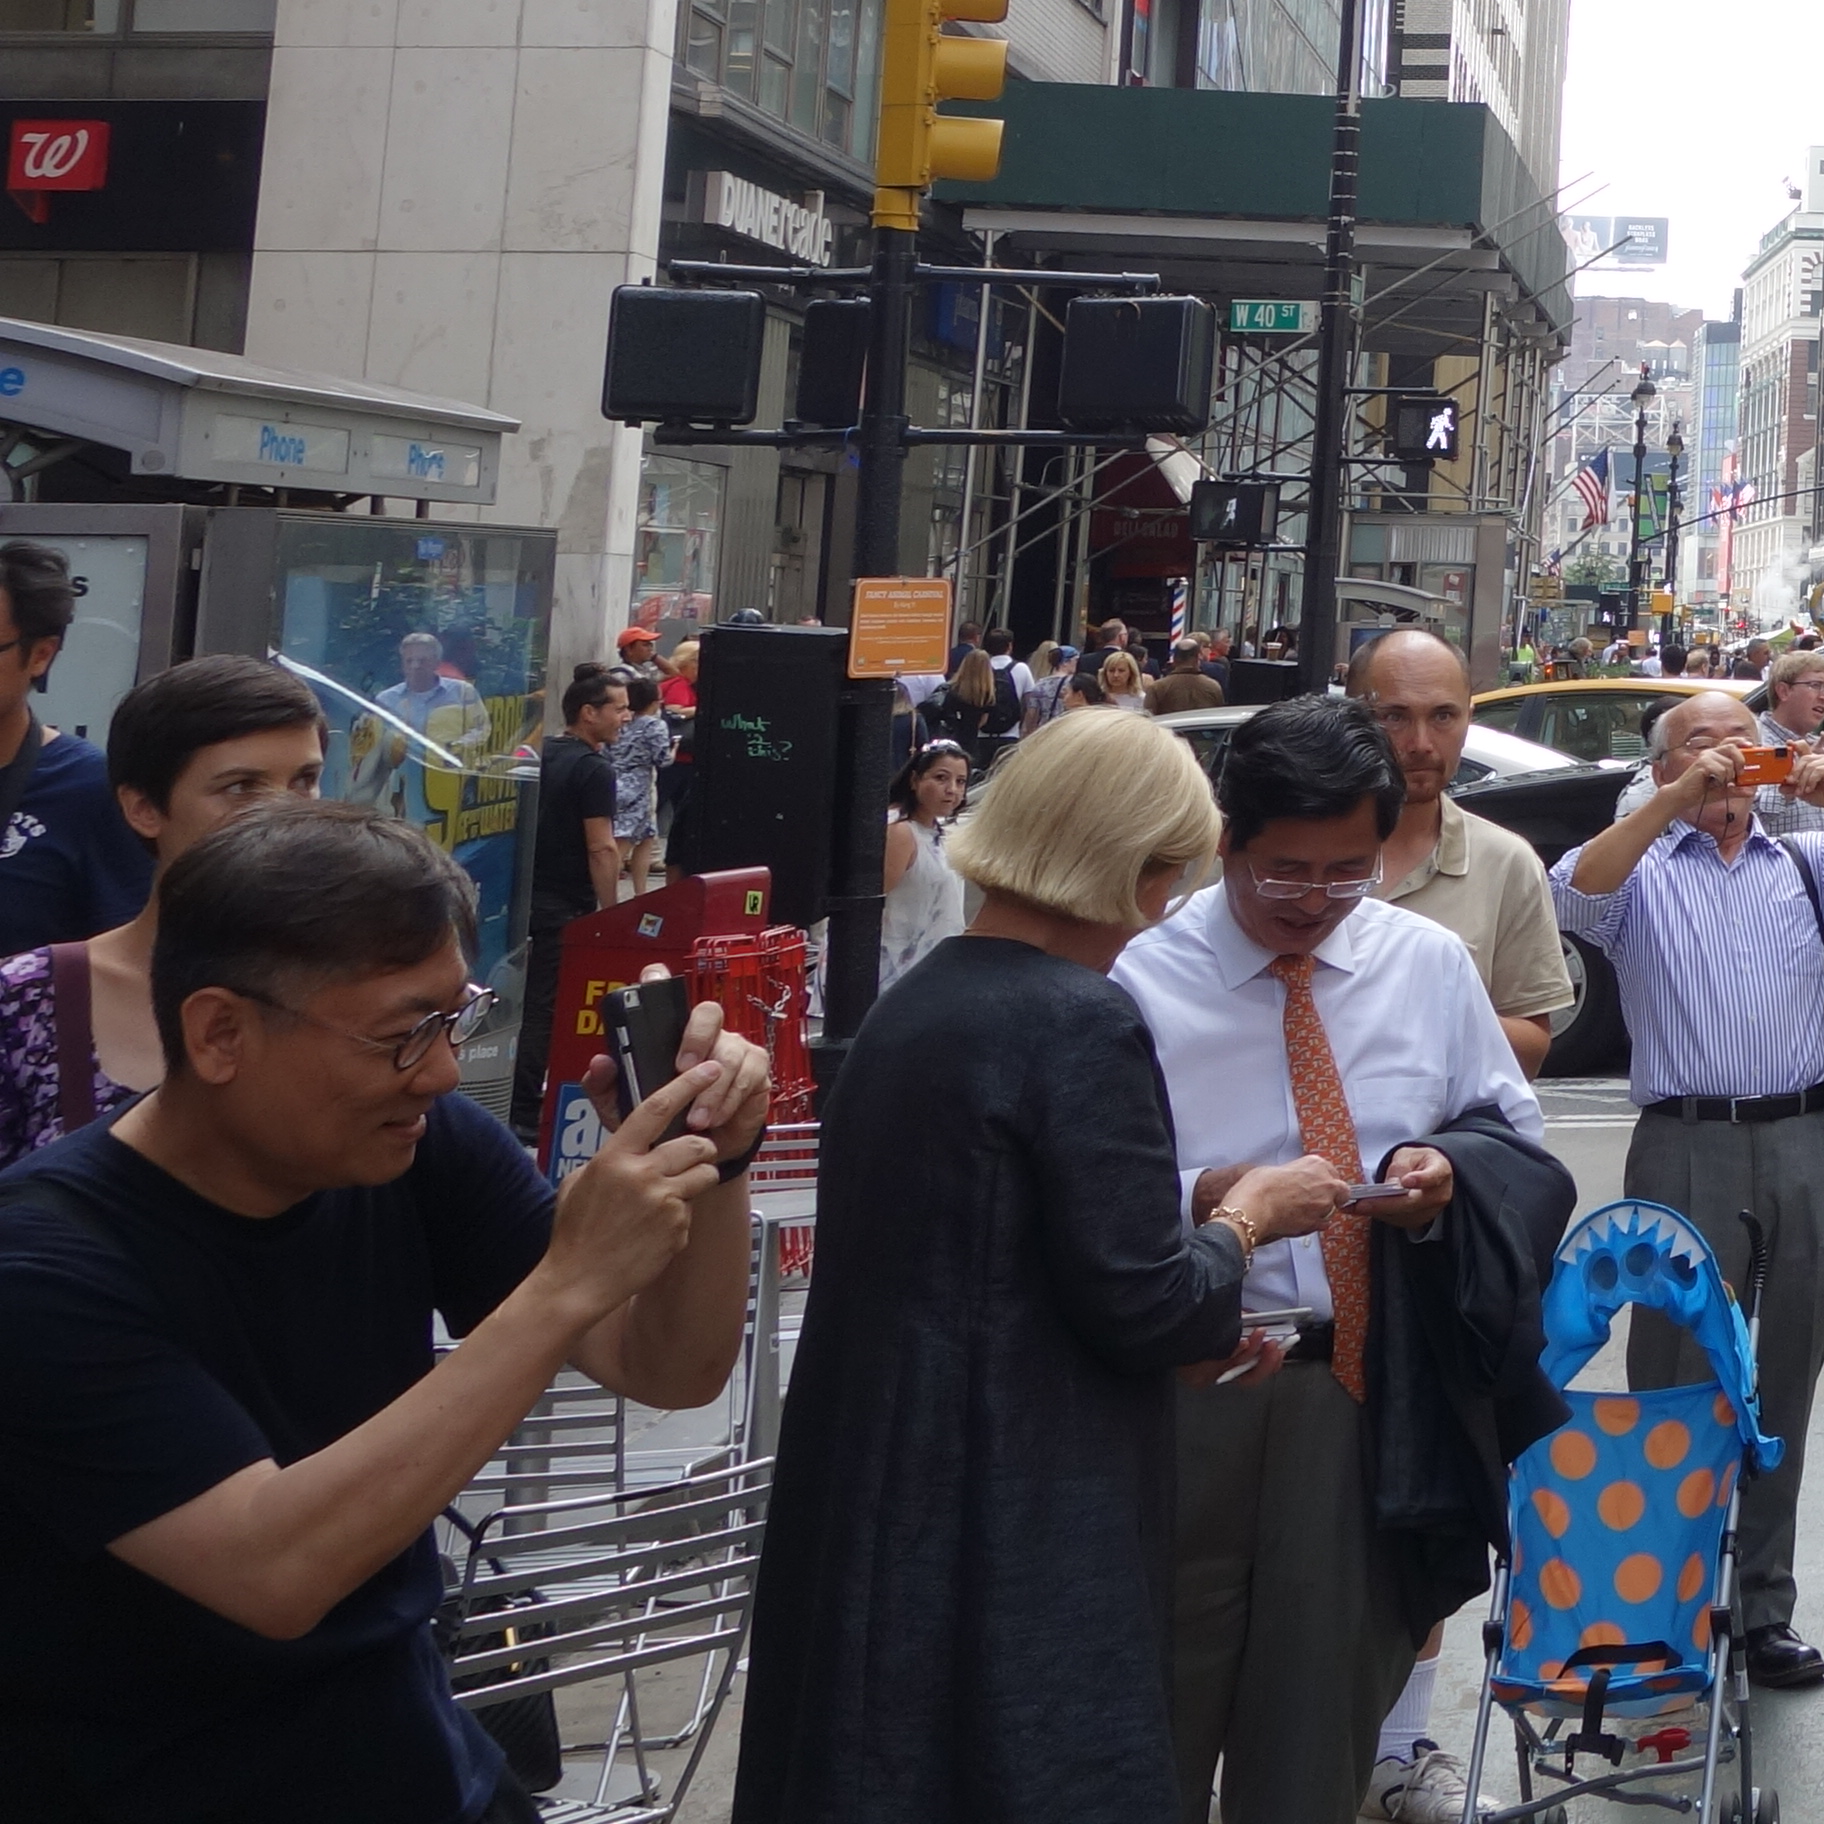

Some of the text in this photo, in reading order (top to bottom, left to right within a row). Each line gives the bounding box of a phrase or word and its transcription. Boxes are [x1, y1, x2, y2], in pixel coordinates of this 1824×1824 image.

[1235, 304, 1295, 328] W 40 ST
[259, 425, 305, 466] Phone
[468, 1044, 499, 1063] place
